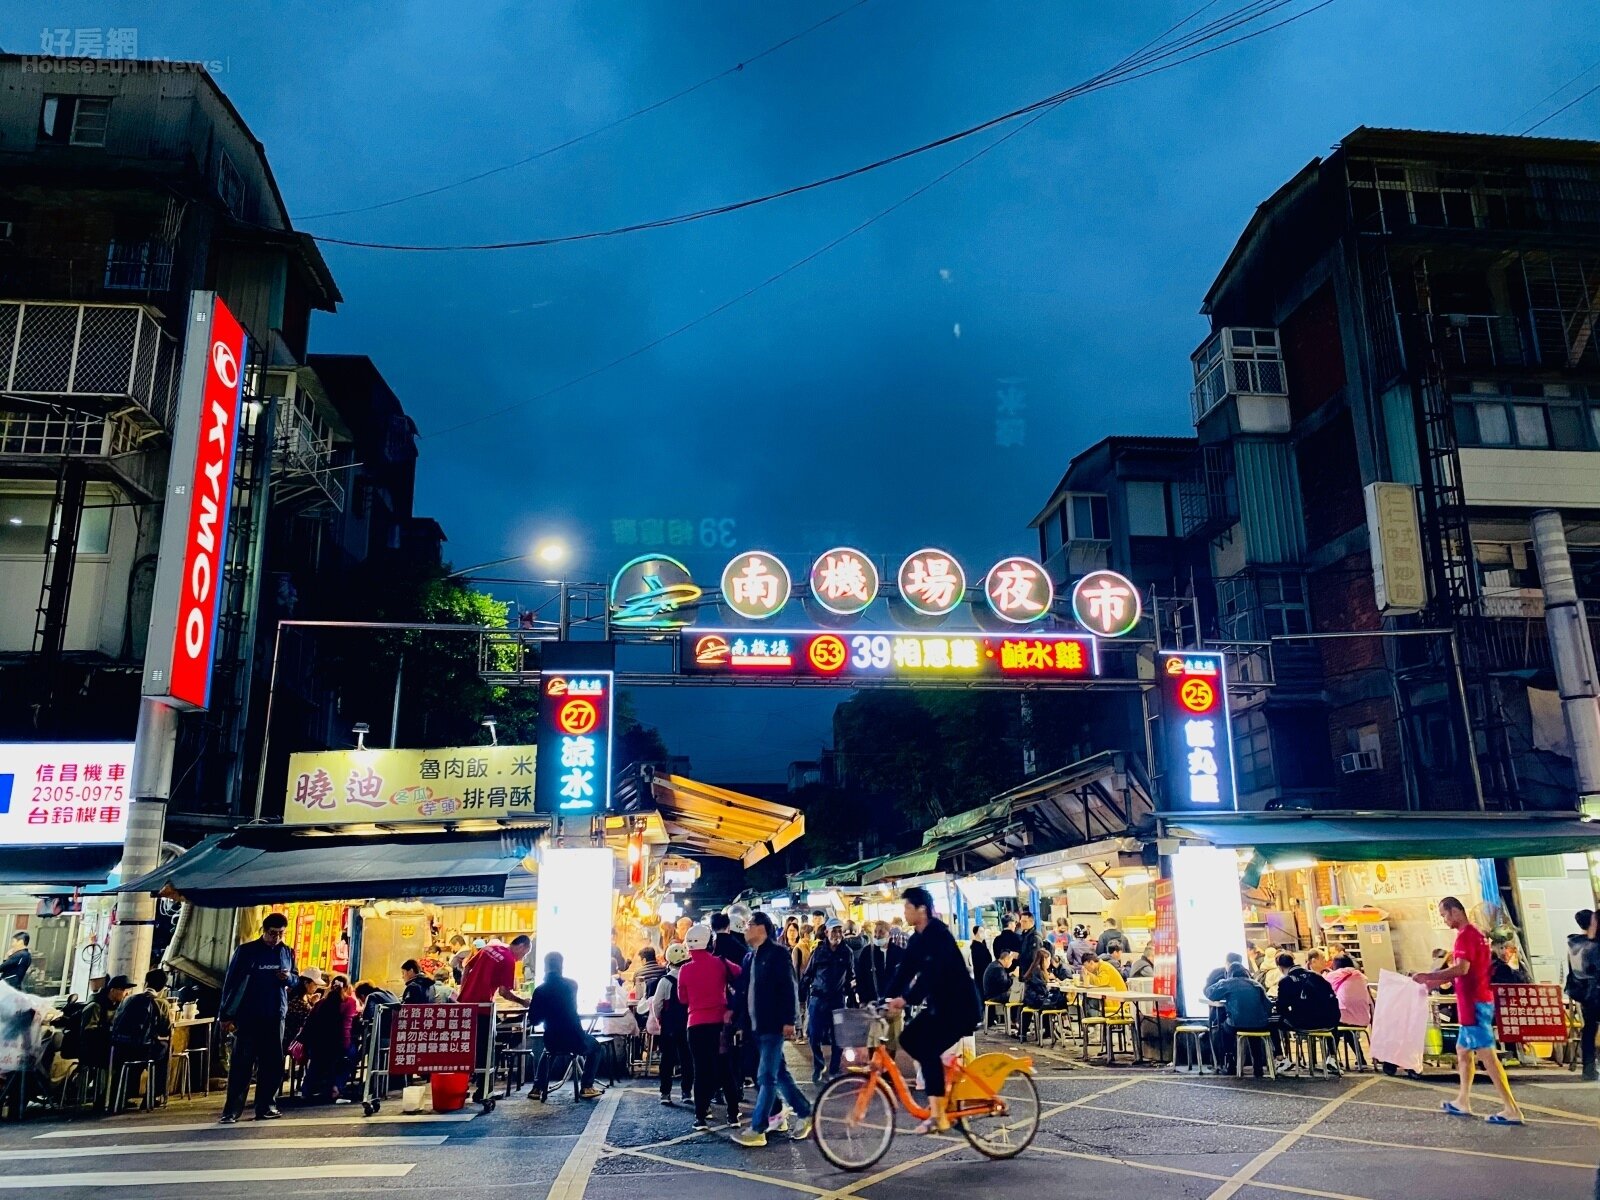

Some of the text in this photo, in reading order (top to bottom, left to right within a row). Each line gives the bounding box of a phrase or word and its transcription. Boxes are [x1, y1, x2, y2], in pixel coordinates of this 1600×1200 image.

[186, 399, 229, 659] KYMCO
[815, 643, 841, 663] 53
[1186, 686, 1209, 704] 25
[566, 707, 591, 727] 27
[36, 763, 126, 782] 信昌機車
[32, 786, 124, 802] 2305-0975
[293, 767, 388, 810] 曉迪
[463, 785, 535, 810] 排骨酥
[28, 806, 121, 824] 台鈴機車
[423, 798, 456, 816] 芋頭
